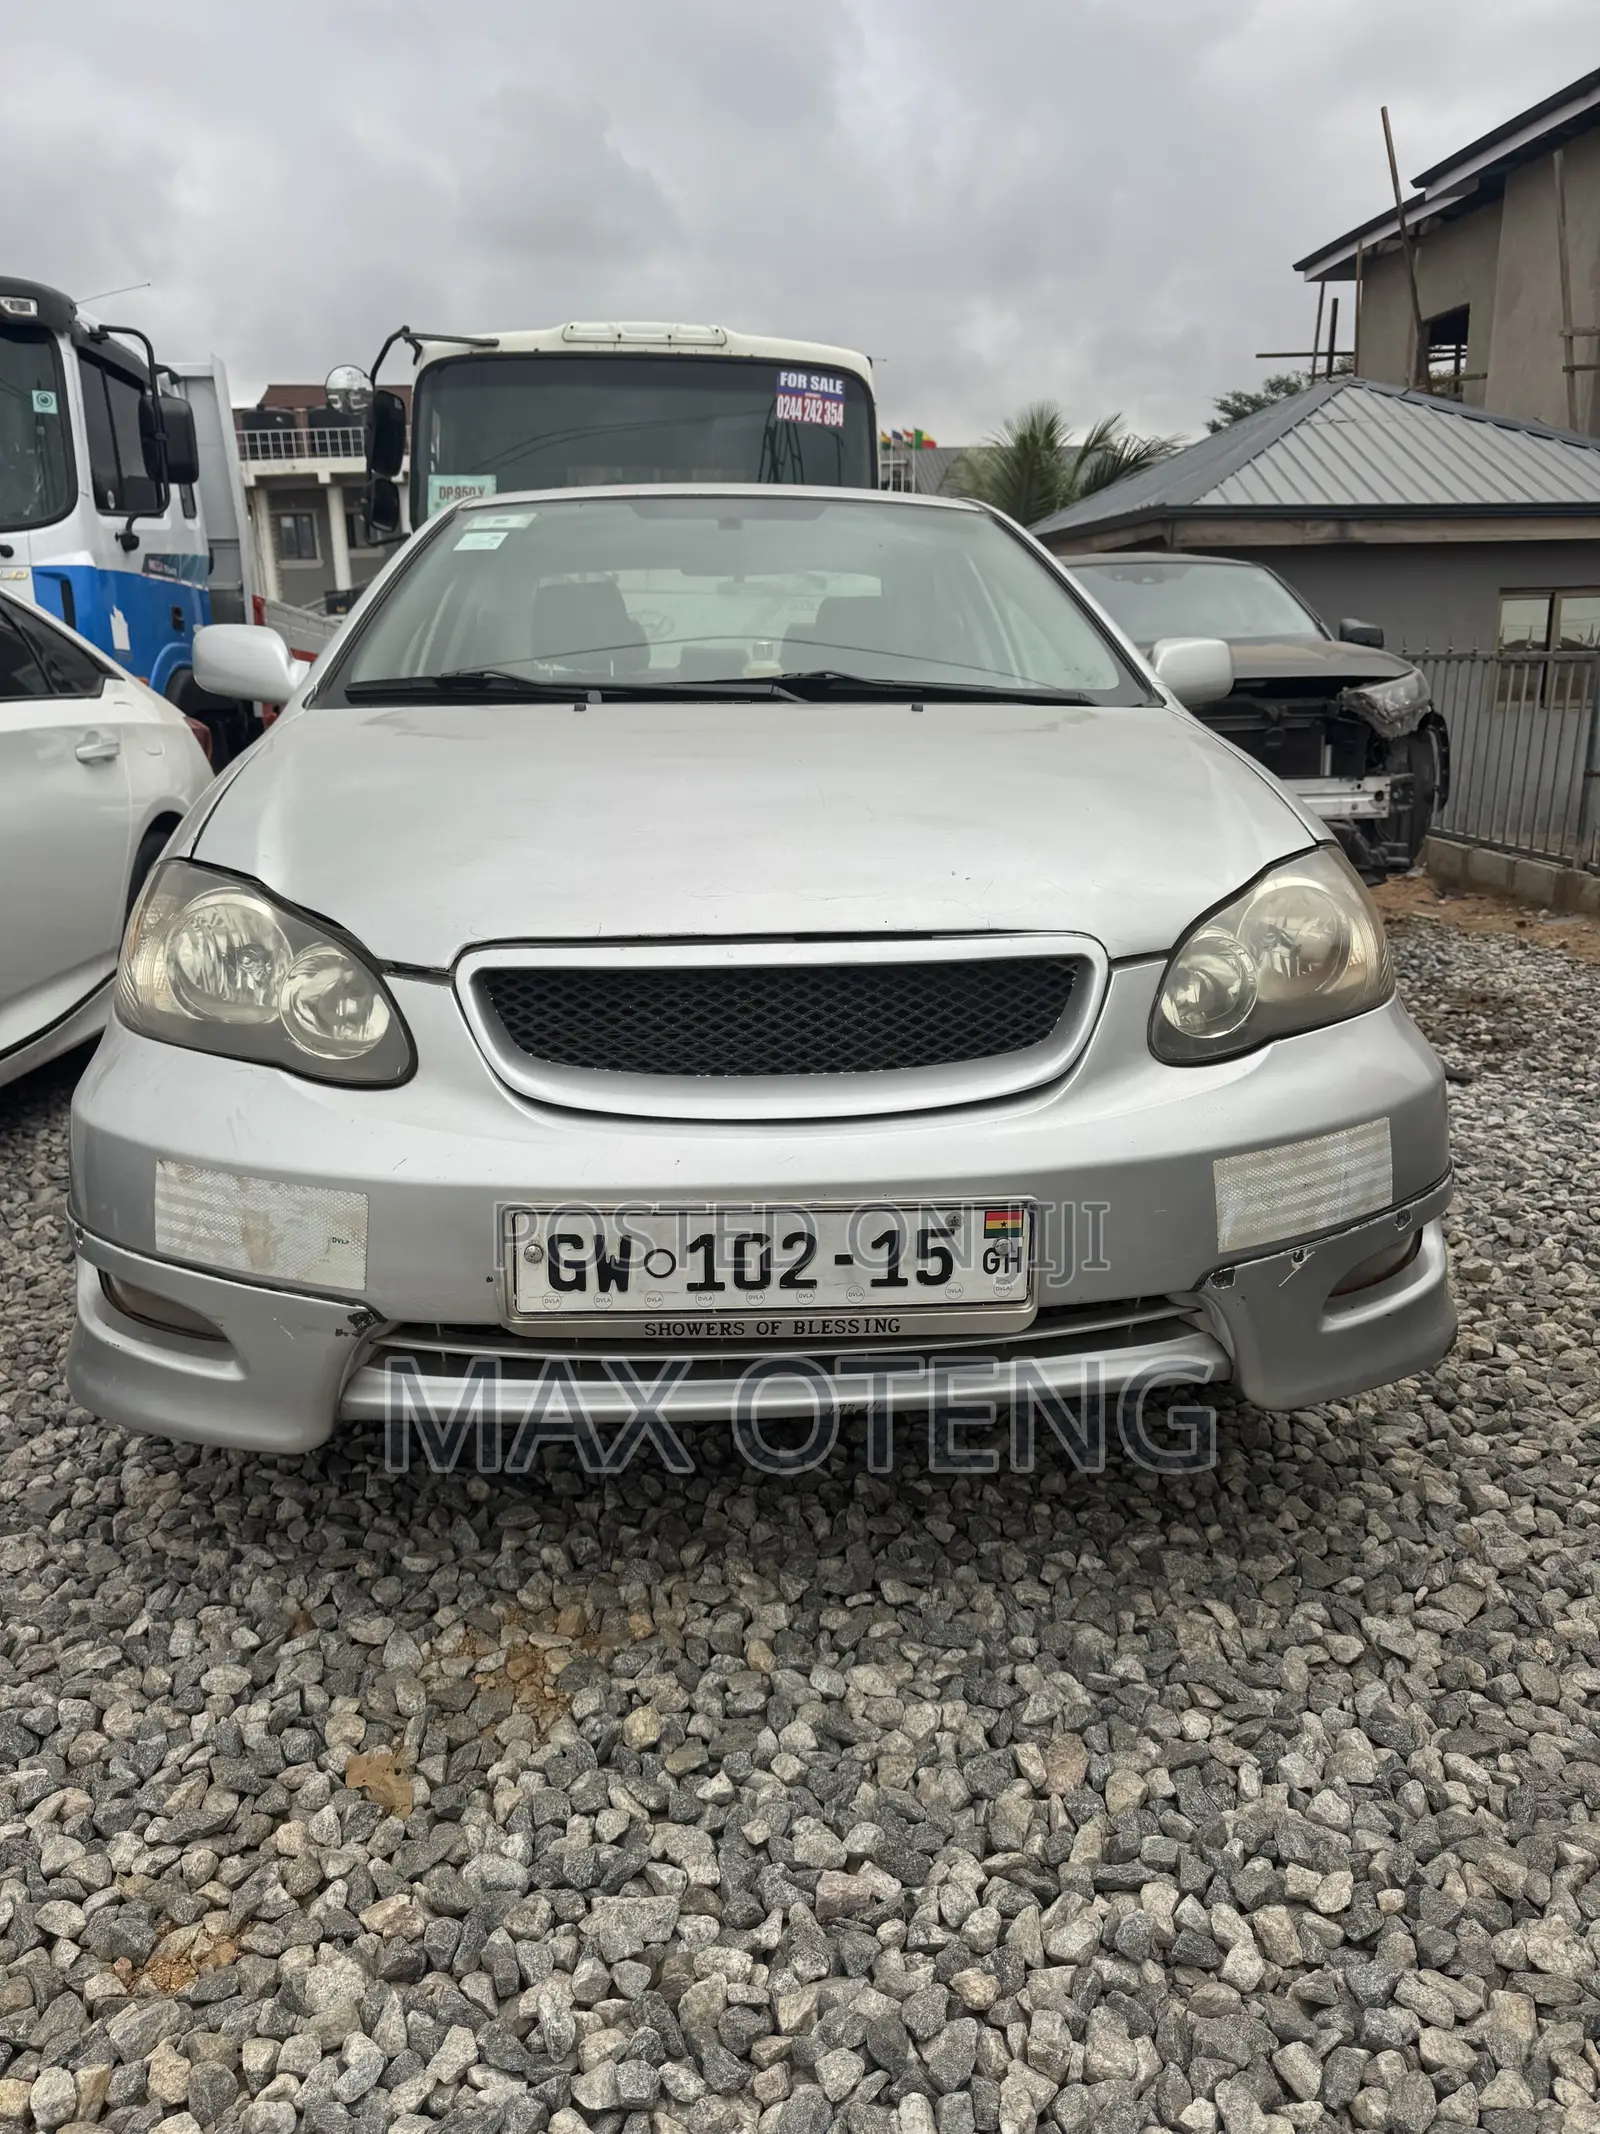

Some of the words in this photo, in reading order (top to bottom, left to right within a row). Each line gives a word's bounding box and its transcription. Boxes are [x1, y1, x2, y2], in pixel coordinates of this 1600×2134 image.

[780, 371, 807, 390] FOR
[810, 375, 844, 395] SALE
[776, 394, 803, 421] 0244
[803, 398, 823, 424] 242
[823, 401, 844, 427] 354
[547, 1232, 632, 1292] GW
[983, 1246, 1023, 1275] GH
[644, 1321, 746, 1337] SHOWERS
[755, 1321, 782, 1336] OF
[793, 1318, 901, 1336] BLESSING
